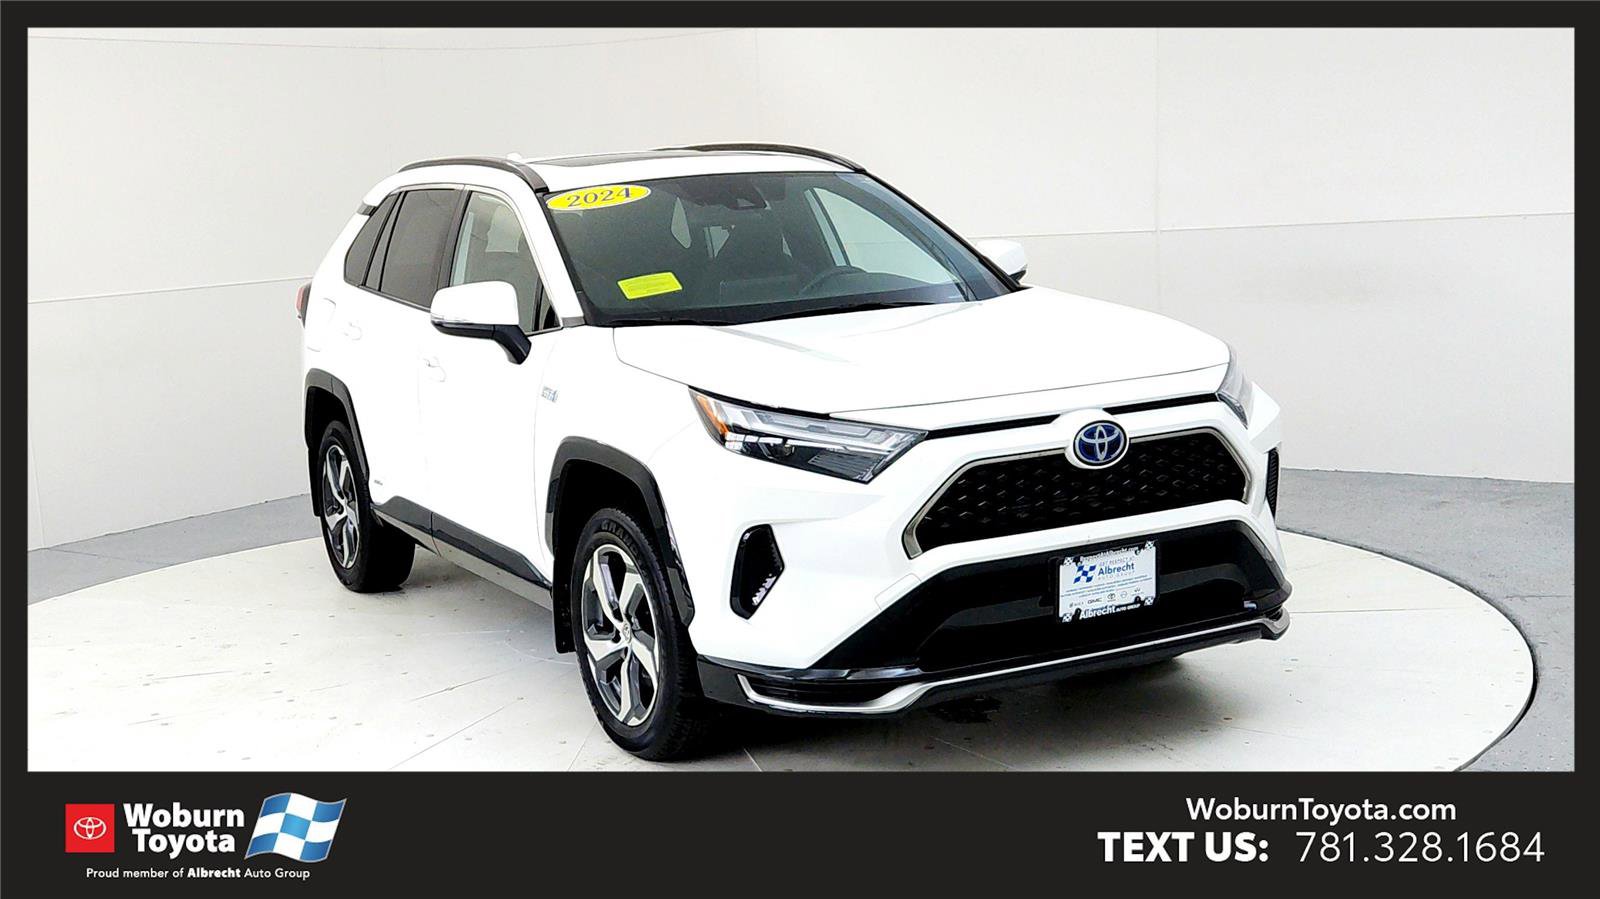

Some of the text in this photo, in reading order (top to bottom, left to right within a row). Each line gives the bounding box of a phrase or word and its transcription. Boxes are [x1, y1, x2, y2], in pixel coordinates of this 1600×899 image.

[567, 187, 633, 208] 2024
[1098, 562, 1135, 576] Albrecht
[1079, 605, 1116, 620] Albrecht
